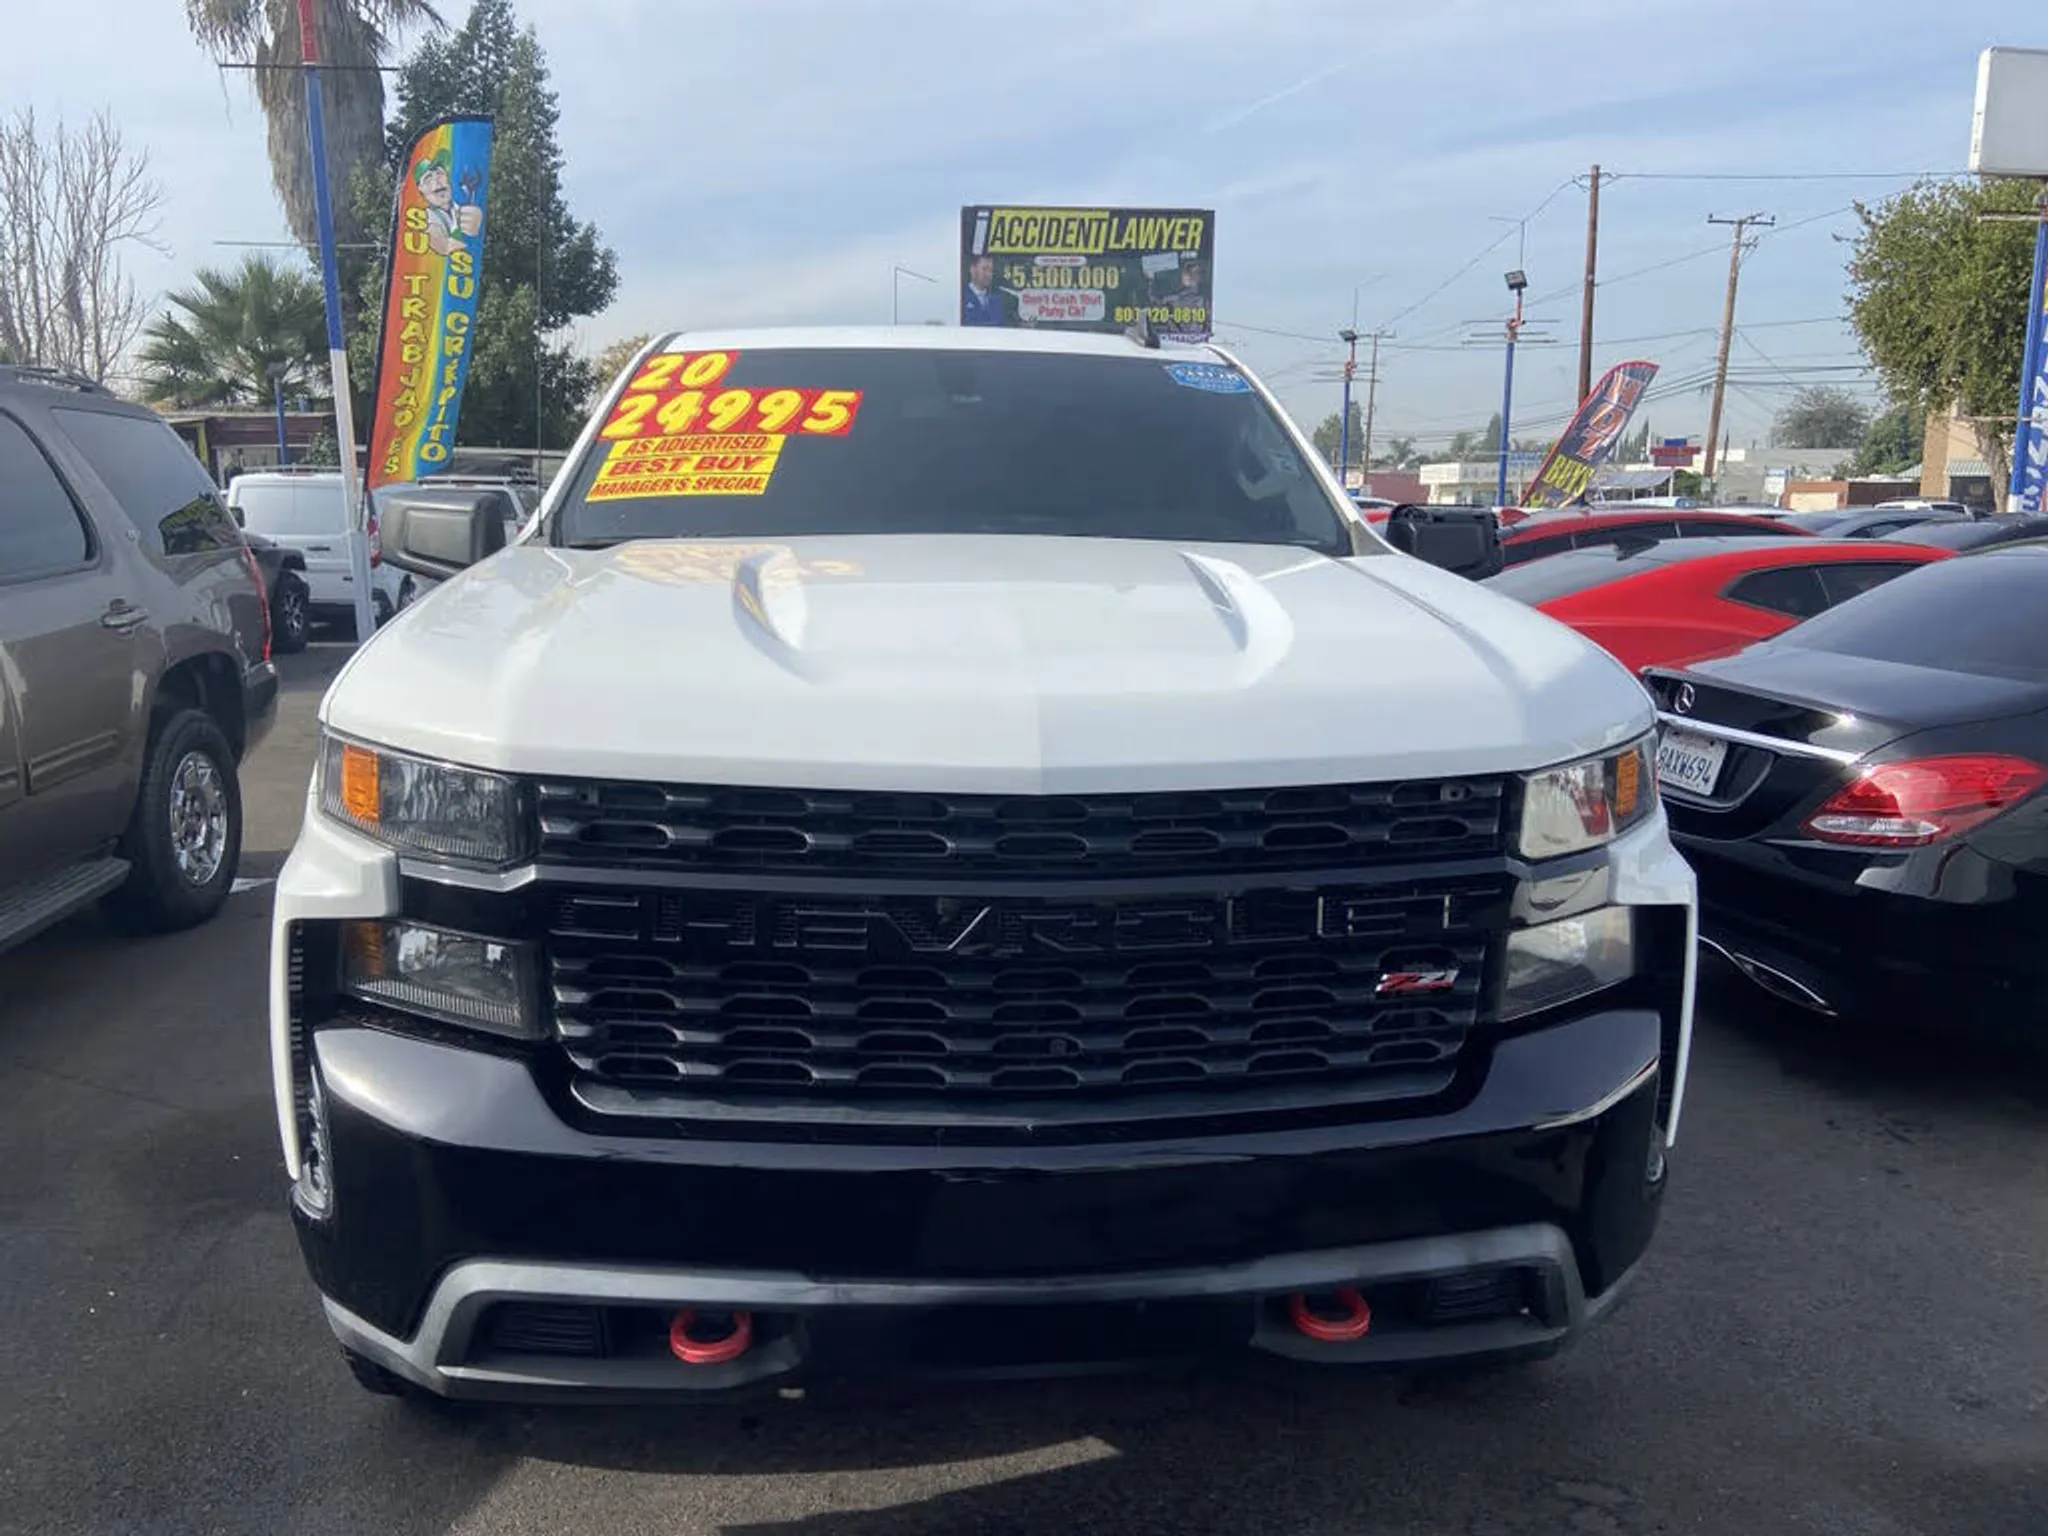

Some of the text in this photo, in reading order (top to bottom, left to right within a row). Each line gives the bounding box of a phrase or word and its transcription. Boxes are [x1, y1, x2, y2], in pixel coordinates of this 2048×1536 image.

[404, 207, 429, 253] SU
[989, 215, 1107, 249] ACCIDENT
[1107, 217, 1204, 251] LAWYER
[447, 251, 474, 299] SU
[630, 352, 729, 389] 20
[601, 389, 858, 438] 24995
[622, 436, 769, 455] AS ADVERTISED
[608, 456, 767, 477] BEST BUY
[1543, 454, 1595, 495] BUYS
[590, 477, 764, 498] MANAGER'S SPECIAL
